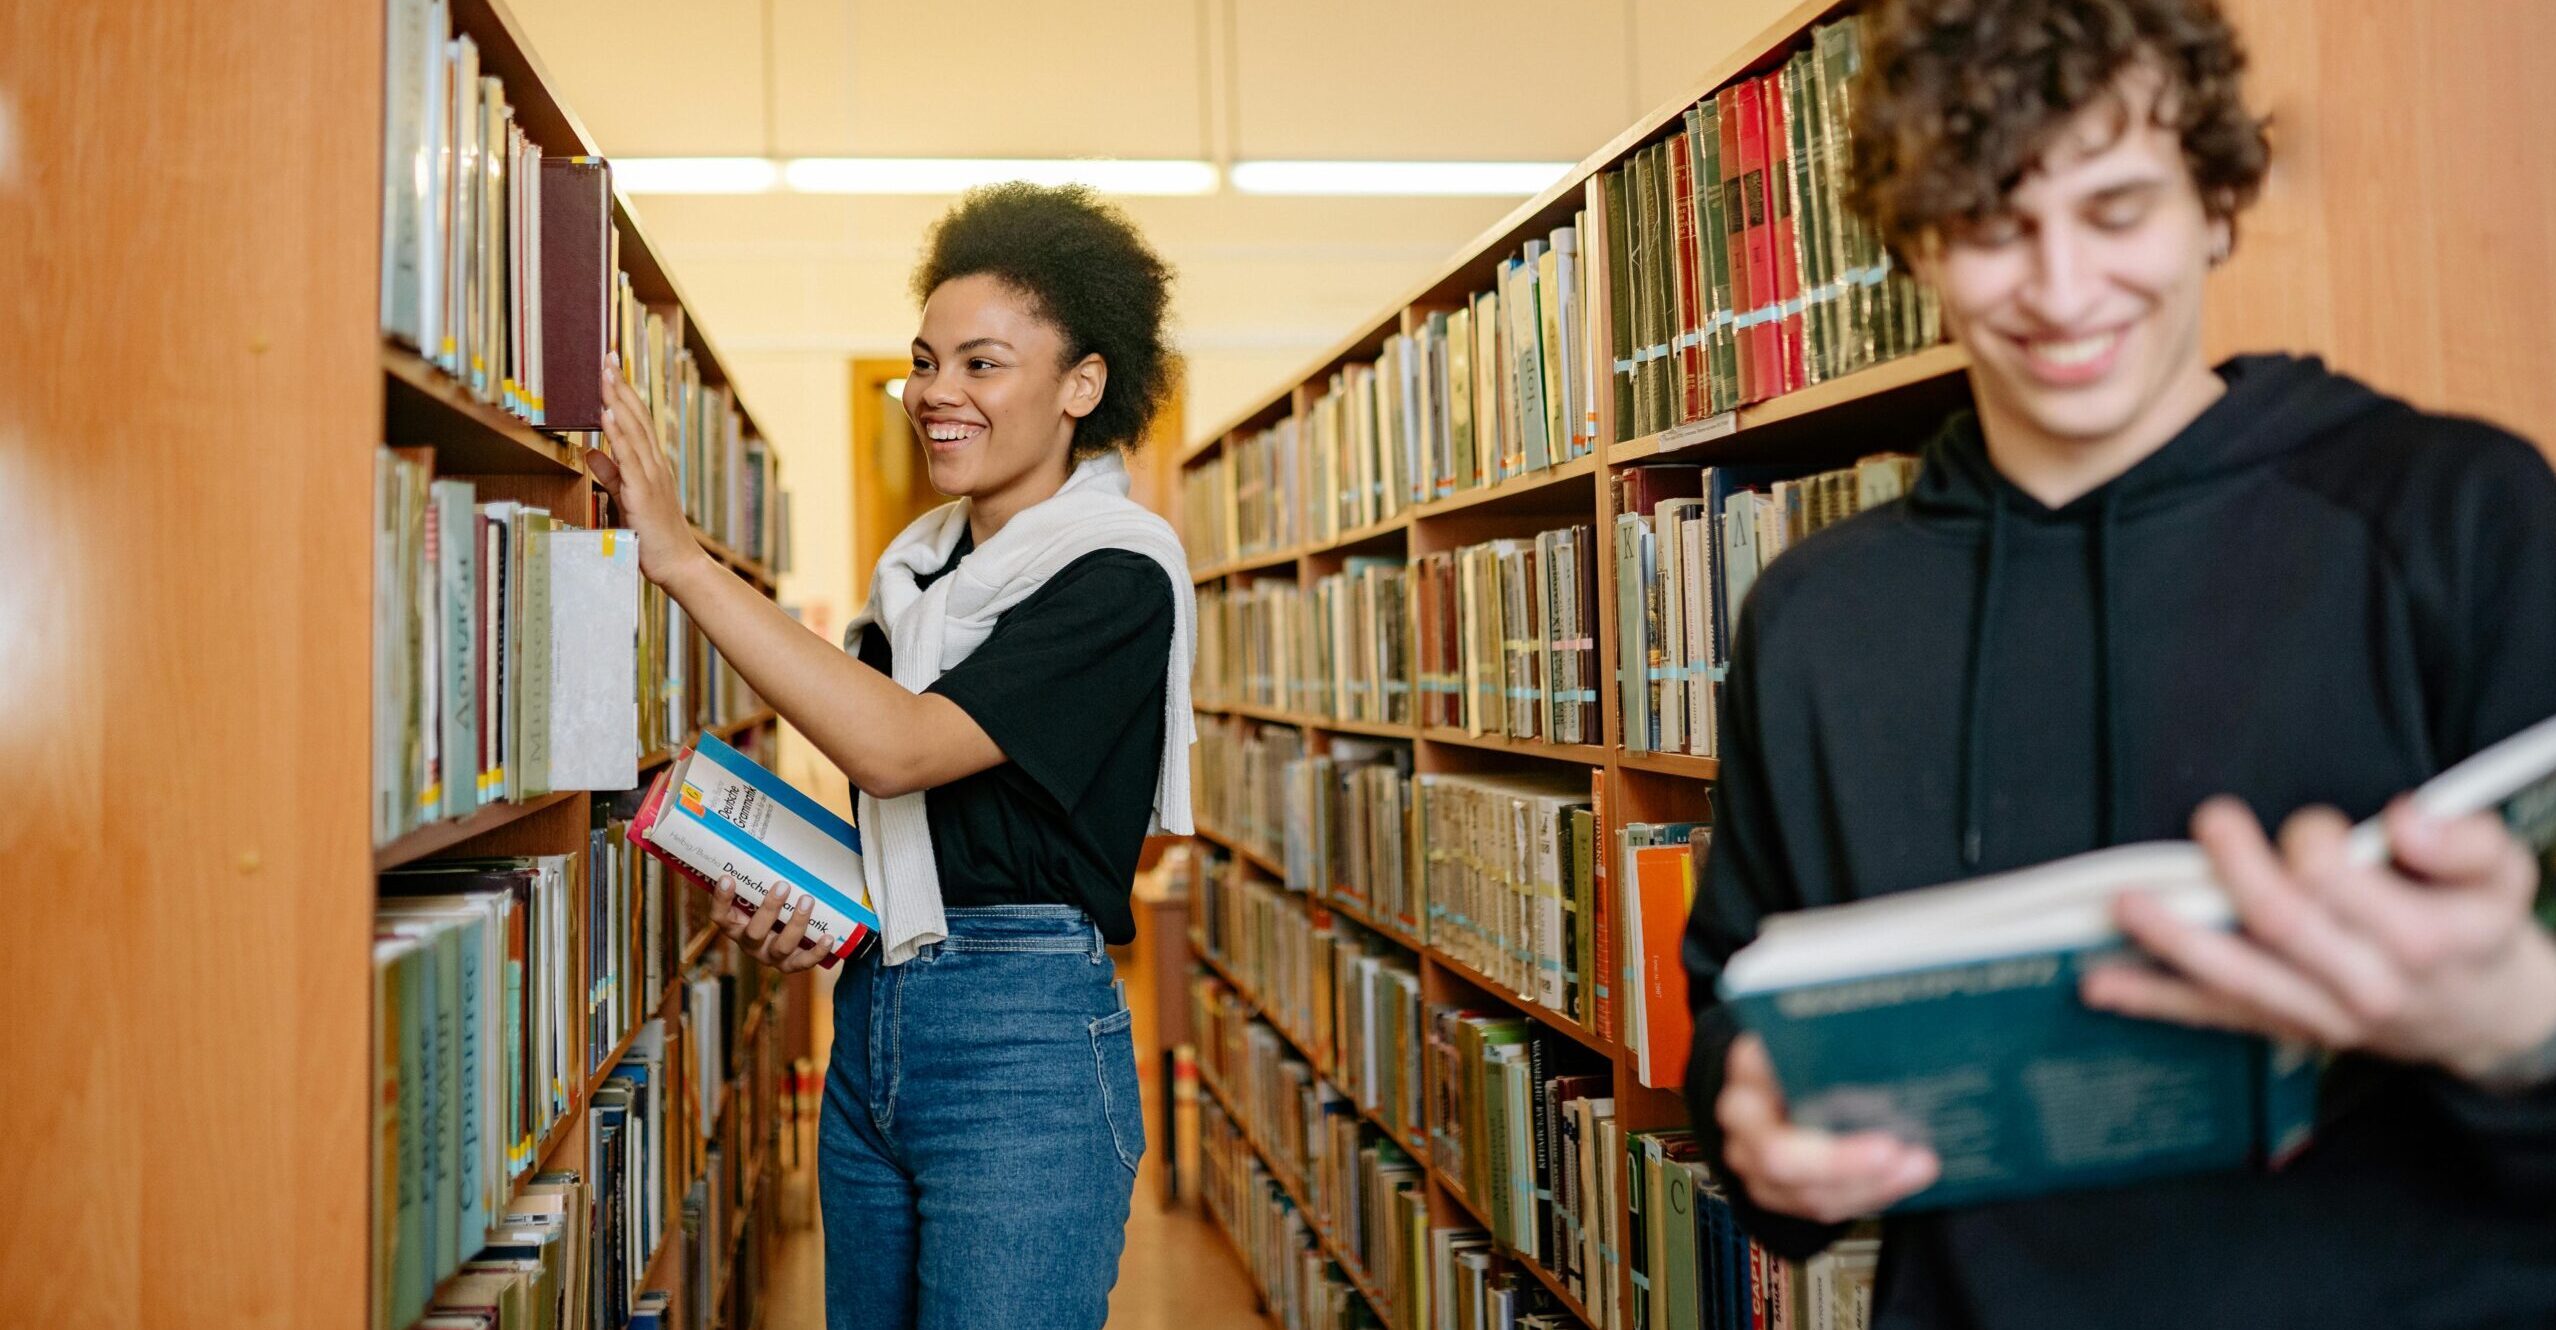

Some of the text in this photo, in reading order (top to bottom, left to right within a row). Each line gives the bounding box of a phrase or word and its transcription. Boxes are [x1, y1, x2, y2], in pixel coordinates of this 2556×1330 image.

[717, 785, 740, 820] Deutsche
[732, 783, 758, 829] Grammatik
[722, 861, 770, 897] Deutsche
[459, 952, 477, 1211] Сервантес
